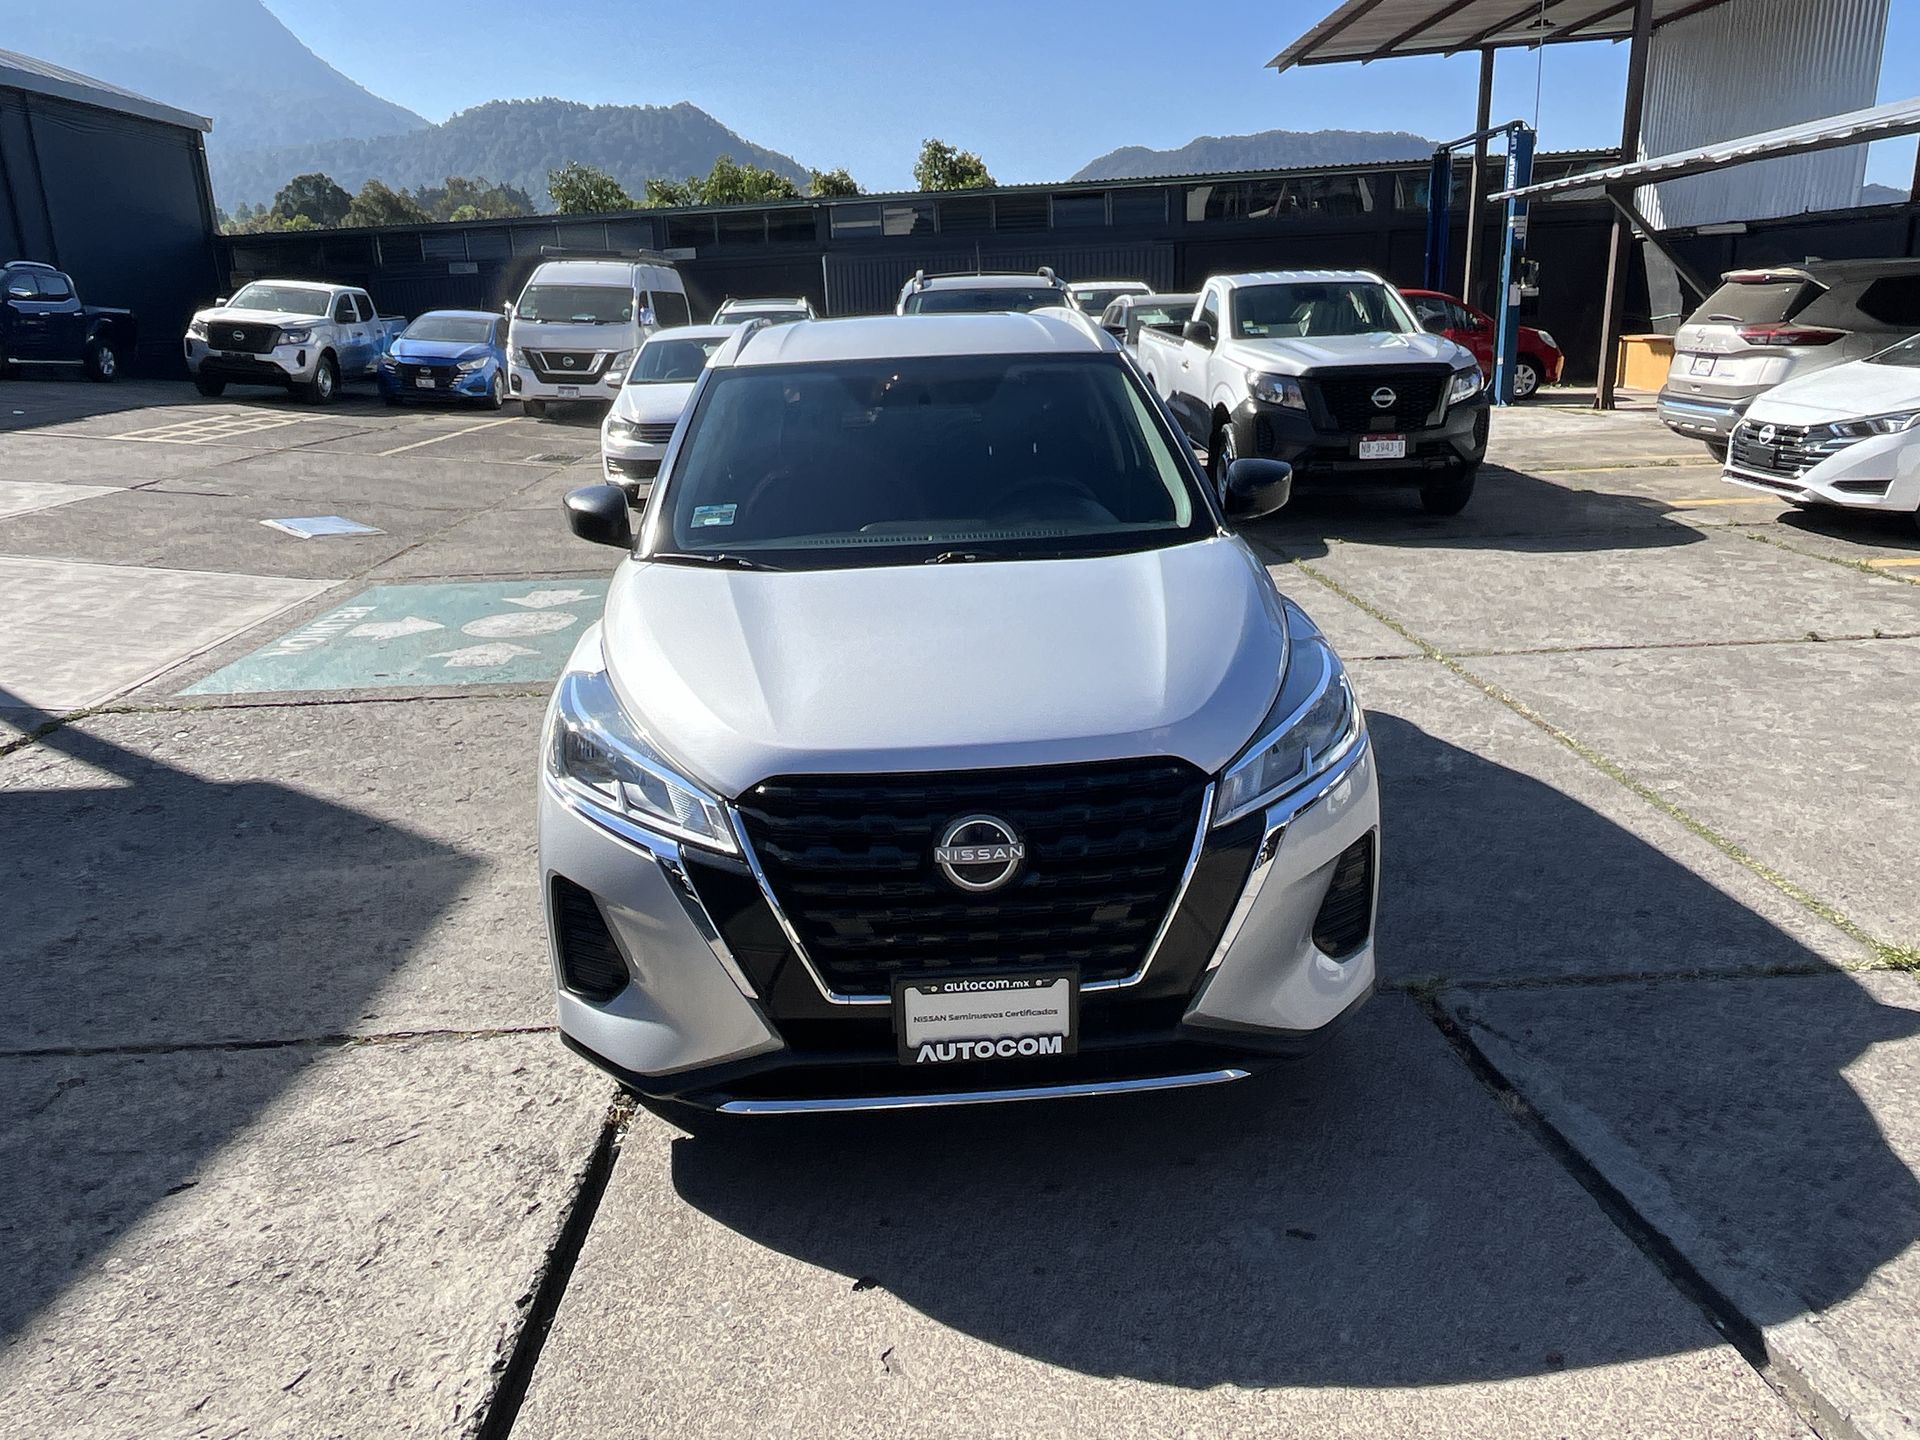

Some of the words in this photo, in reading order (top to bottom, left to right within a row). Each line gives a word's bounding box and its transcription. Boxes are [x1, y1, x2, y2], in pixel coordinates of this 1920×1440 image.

[1507, 152, 1516, 189] ROTARY
[936, 845, 1022, 861] NISSAN
[944, 978, 1030, 993] autocom.mx
[913, 1014, 947, 1024] NISSAN
[948, 1011, 1003, 1021] Seminuevos
[1005, 1008, 1059, 1018] Certificados
[916, 1036, 1062, 1063] AUTOCOM
